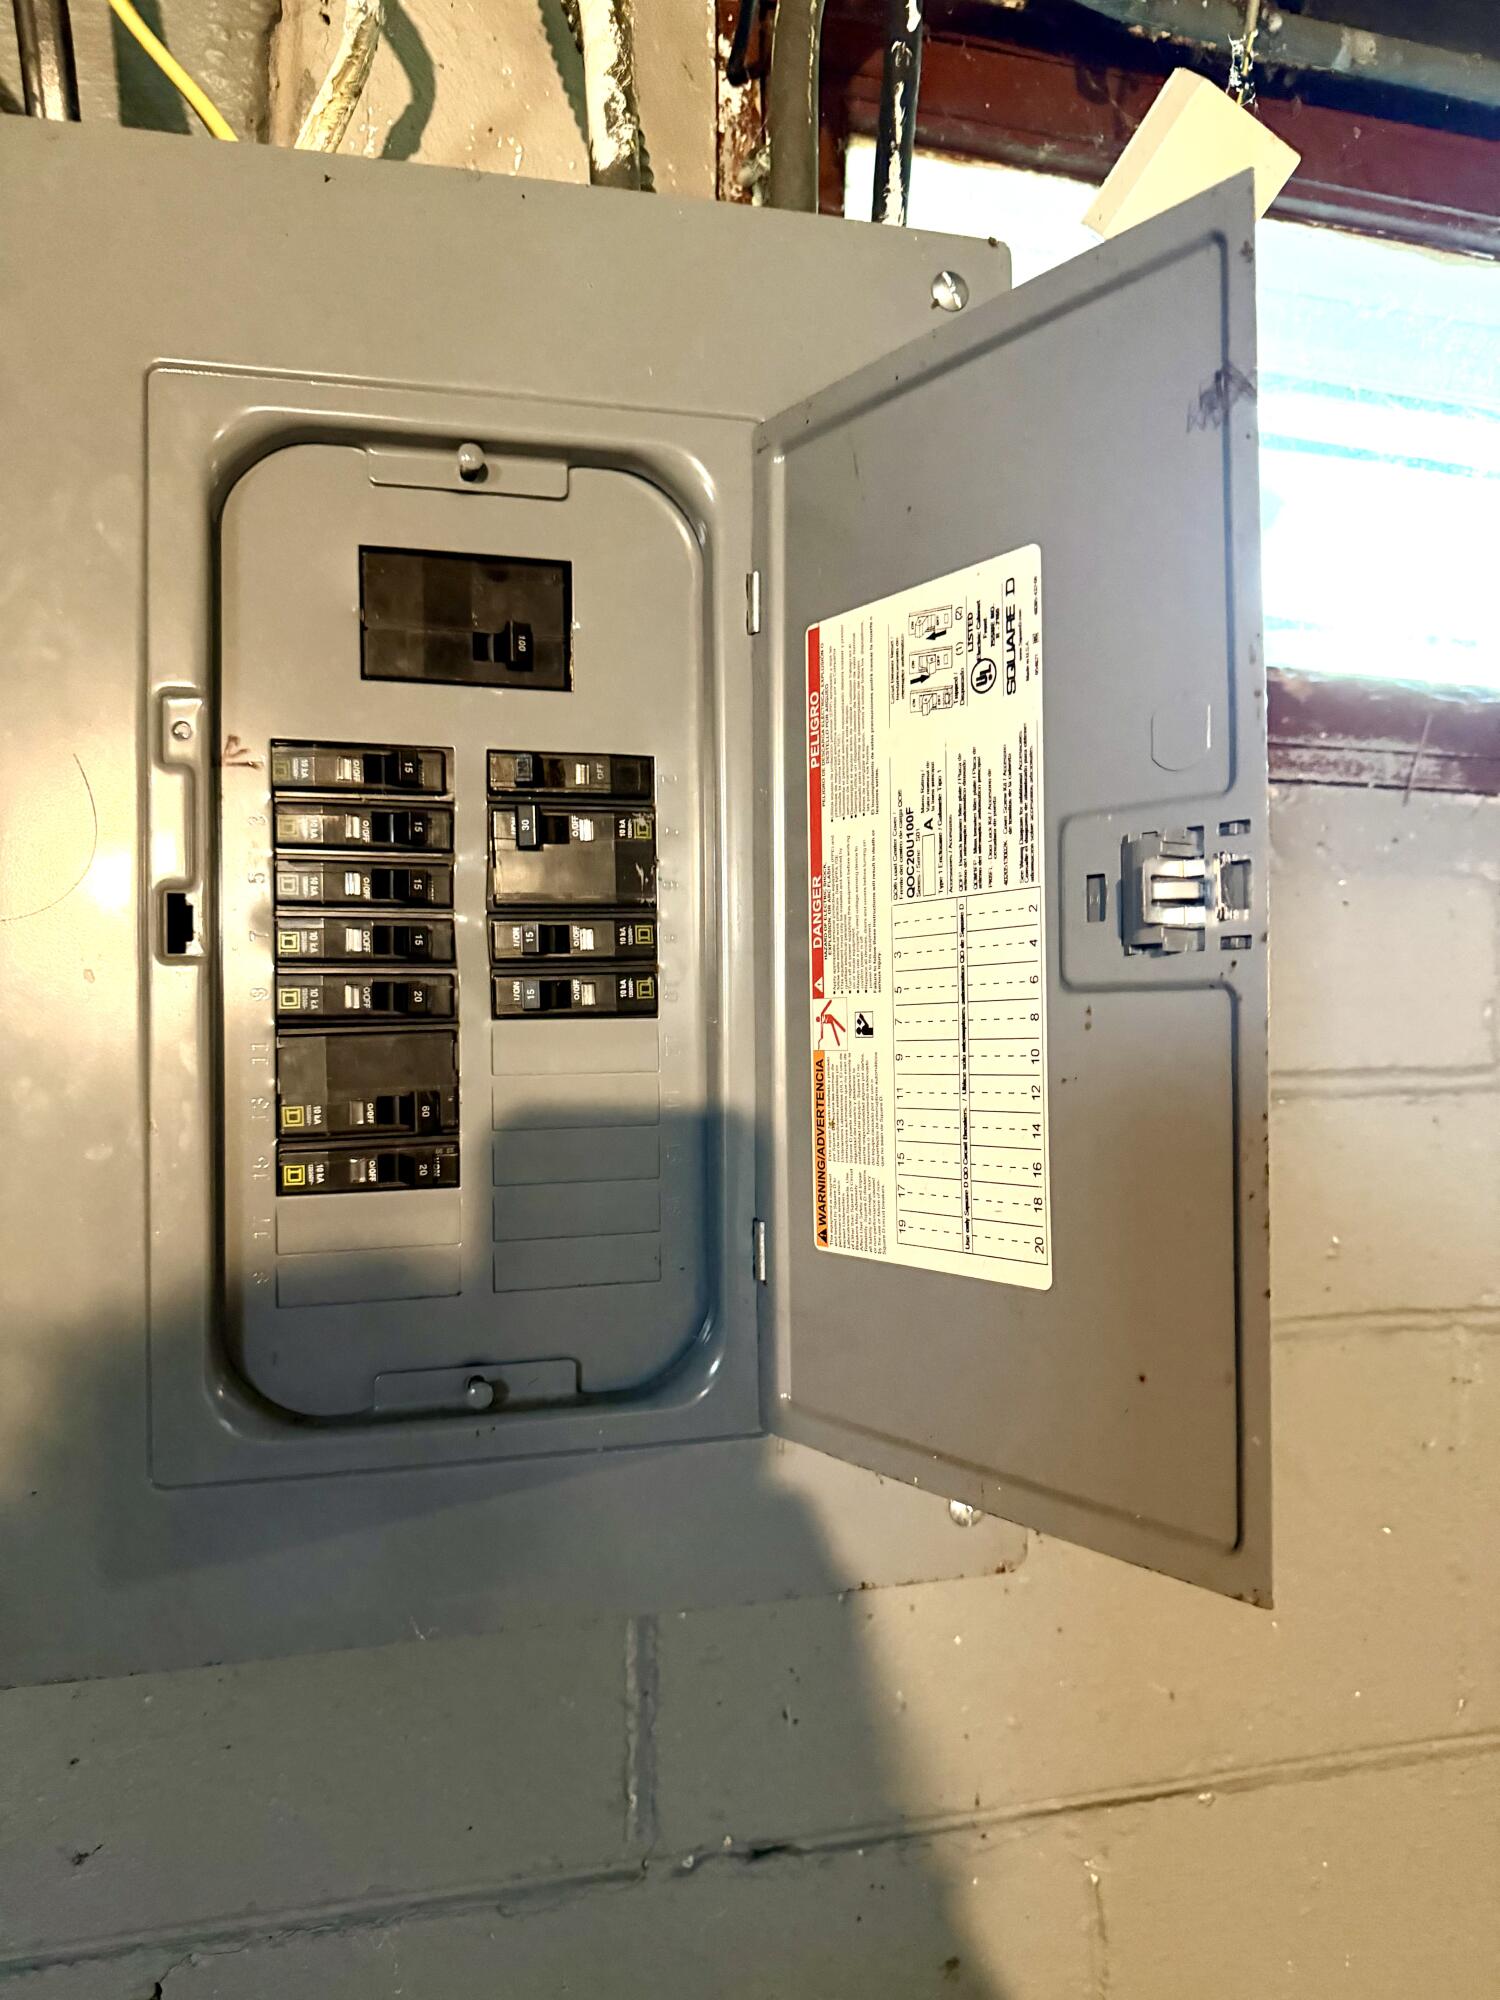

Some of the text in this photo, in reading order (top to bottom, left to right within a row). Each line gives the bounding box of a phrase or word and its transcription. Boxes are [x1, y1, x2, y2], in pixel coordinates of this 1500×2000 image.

[955, 606, 963, 620] (2)
[1006, 576, 1016, 695] SQUARE D
[518, 635, 526, 652] 100
[955, 641, 964, 655] (1)
[810, 691, 820, 768] PELIGRO
[404, 762, 413, 773] 15
[414, 822, 423, 833] 15
[521, 819, 530, 831] 30
[924, 817, 933, 830] A
[906, 806, 915, 898] QOC20U100F
[414, 879, 422, 890] 15
[812, 875, 822, 949] DANGER
[1028, 904, 1037, 912] 2
[414, 934, 423, 946] 15
[526, 931, 534, 942] 15
[619, 926, 627, 945] 10 kA
[894, 950, 901, 958] 3
[1029, 975, 1038, 983] 6
[527, 989, 535, 1000] 15
[619, 978, 627, 998] 10 kA
[414, 990, 422, 1003] 20
[1030, 1013, 1039, 1021] 8
[1030, 1048, 1040, 1064] 10
[897, 1087, 904, 1099] 11
[1032, 1084, 1040, 1100] 12
[313, 1105, 321, 1114] 10
[422, 1105, 430, 1118] 60
[897, 1118, 904, 1132] 13
[1032, 1123, 1041, 1138] 14
[816, 1058, 826, 1225] WARNING/ADVERTENCIA
[897, 1152, 904, 1166] 15
[315, 1164, 324, 1174] 10
[419, 1164, 428, 1177] 20
[1033, 1161, 1042, 1177] 16
[898, 1184, 905, 1197] 17
[1034, 1197, 1043, 1212] 18
[898, 1219, 906, 1233] 19
[1034, 1236, 1044, 1254] 20
